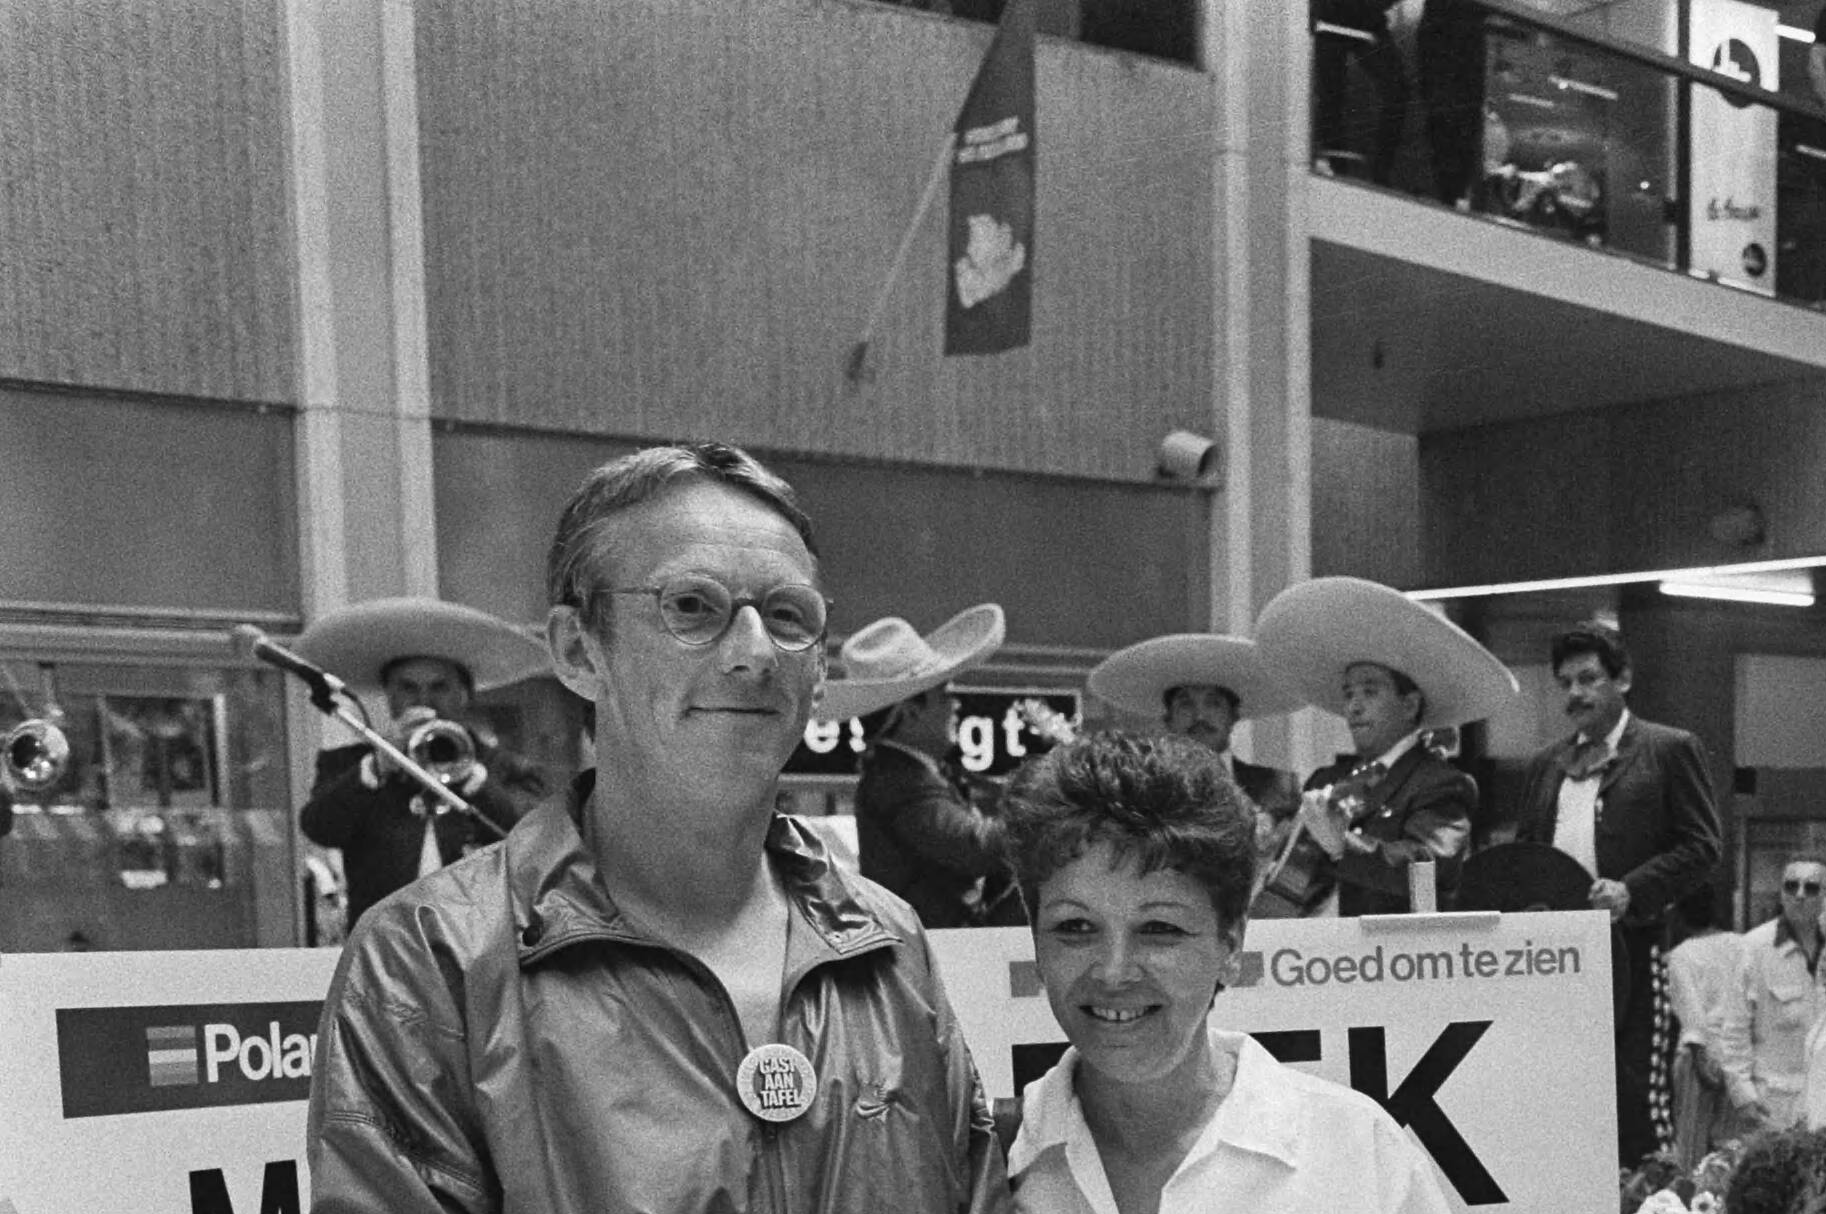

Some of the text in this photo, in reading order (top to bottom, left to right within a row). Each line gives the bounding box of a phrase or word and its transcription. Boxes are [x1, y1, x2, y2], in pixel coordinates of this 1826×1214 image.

[204, 940, 1580, 1083] Pola Goed om te zien
[760, 1058, 796, 1074] GAST
[764, 1072, 794, 1091] AAN
[761, 1088, 801, 1110] TAFEL
